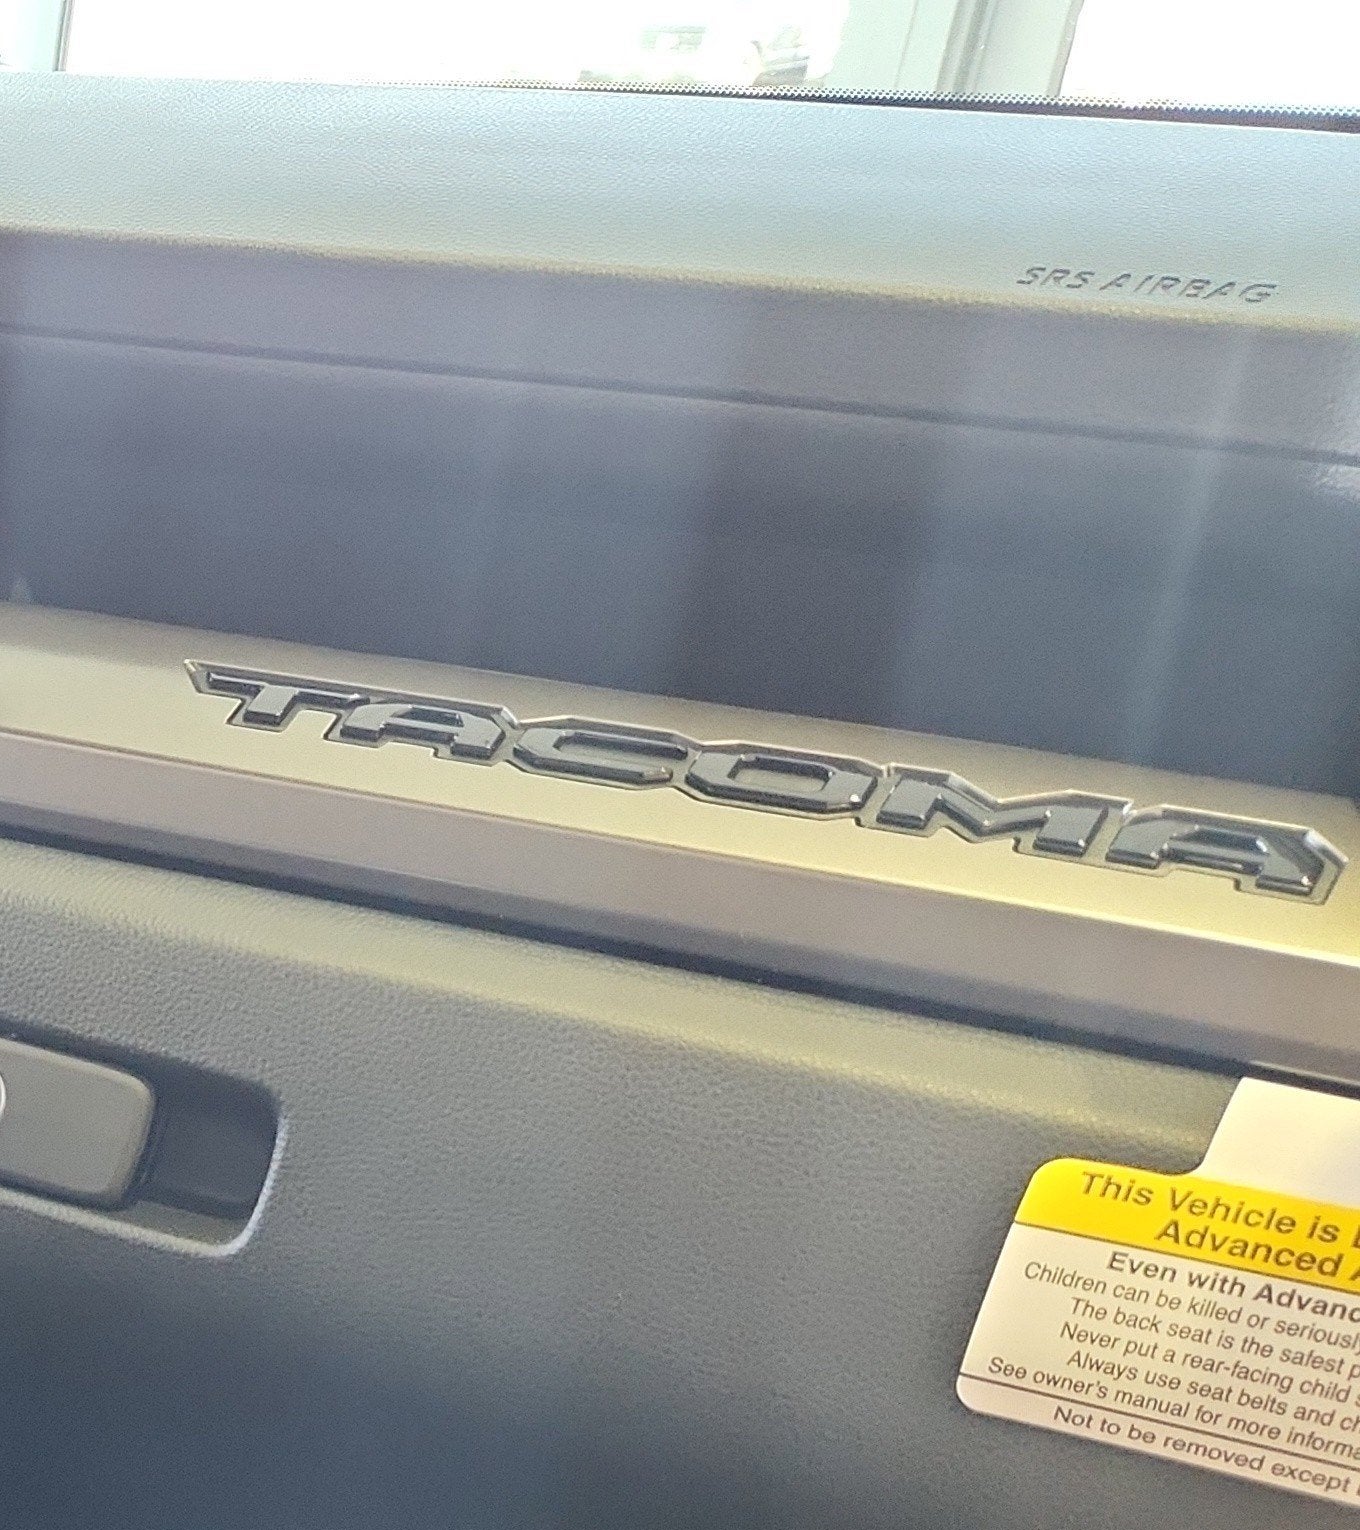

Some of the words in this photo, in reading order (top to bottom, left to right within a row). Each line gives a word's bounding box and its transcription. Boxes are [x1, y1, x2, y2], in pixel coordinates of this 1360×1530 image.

[1016, 266, 1095, 290] SRS
[1098, 272, 1278, 303] AIRBAG
[185, 660, 1349, 906] TACOMA
[1081, 1171, 1154, 1206] This
[1169, 1186, 1297, 1235] Vehicle
[1306, 1215, 1341, 1243] is
[1105, 1250, 1177, 1283] Even
[1187, 1271, 1247, 1298] with
[1153, 1218, 1344, 1278] Advanced
[1024, 1261, 1107, 1294] Children
[1112, 1283, 1150, 1304] can
[1154, 1289, 1181, 1311] be
[1186, 1296, 1243, 1324] killed
[1246, 1312, 1270, 1330] or
[1059, 1321, 1121, 1351] Never
[1122, 1339, 1160, 1360] put
[1162, 1349, 1176, 1364] a
[1182, 1351, 1294, 1394] rear-facing
[1299, 1378, 1352, 1405] child
[1070, 1297, 1107, 1320] The
[1113, 1306, 1163, 1334] back
[1166, 1322, 1212, 1346] seat
[1216, 1331, 1235, 1350] is
[1240, 1336, 1274, 1360] the
[1279, 1346, 1345, 1376] safest
[987, 1356, 1028, 1380] See
[1032, 1370, 1109, 1399] owner's
[1114, 1389, 1191, 1419] manual
[1194, 1403, 1223, 1427] for
[1226, 1416, 1282, 1441] more
[1066, 1350, 1139, 1381] Always
[1144, 1373, 1181, 1392] use
[1186, 1378, 1233, 1403] seat
[1237, 1387, 1289, 1416] belts
[1293, 1404, 1336, 1428] and
[1053, 1405, 1094, 1430] Not
[1099, 1417, 1122, 1436] to
[1127, 1424, 1157, 1444] be
[1162, 1434, 1267, 1473] removed
[1270, 1460, 1352, 1493] except
